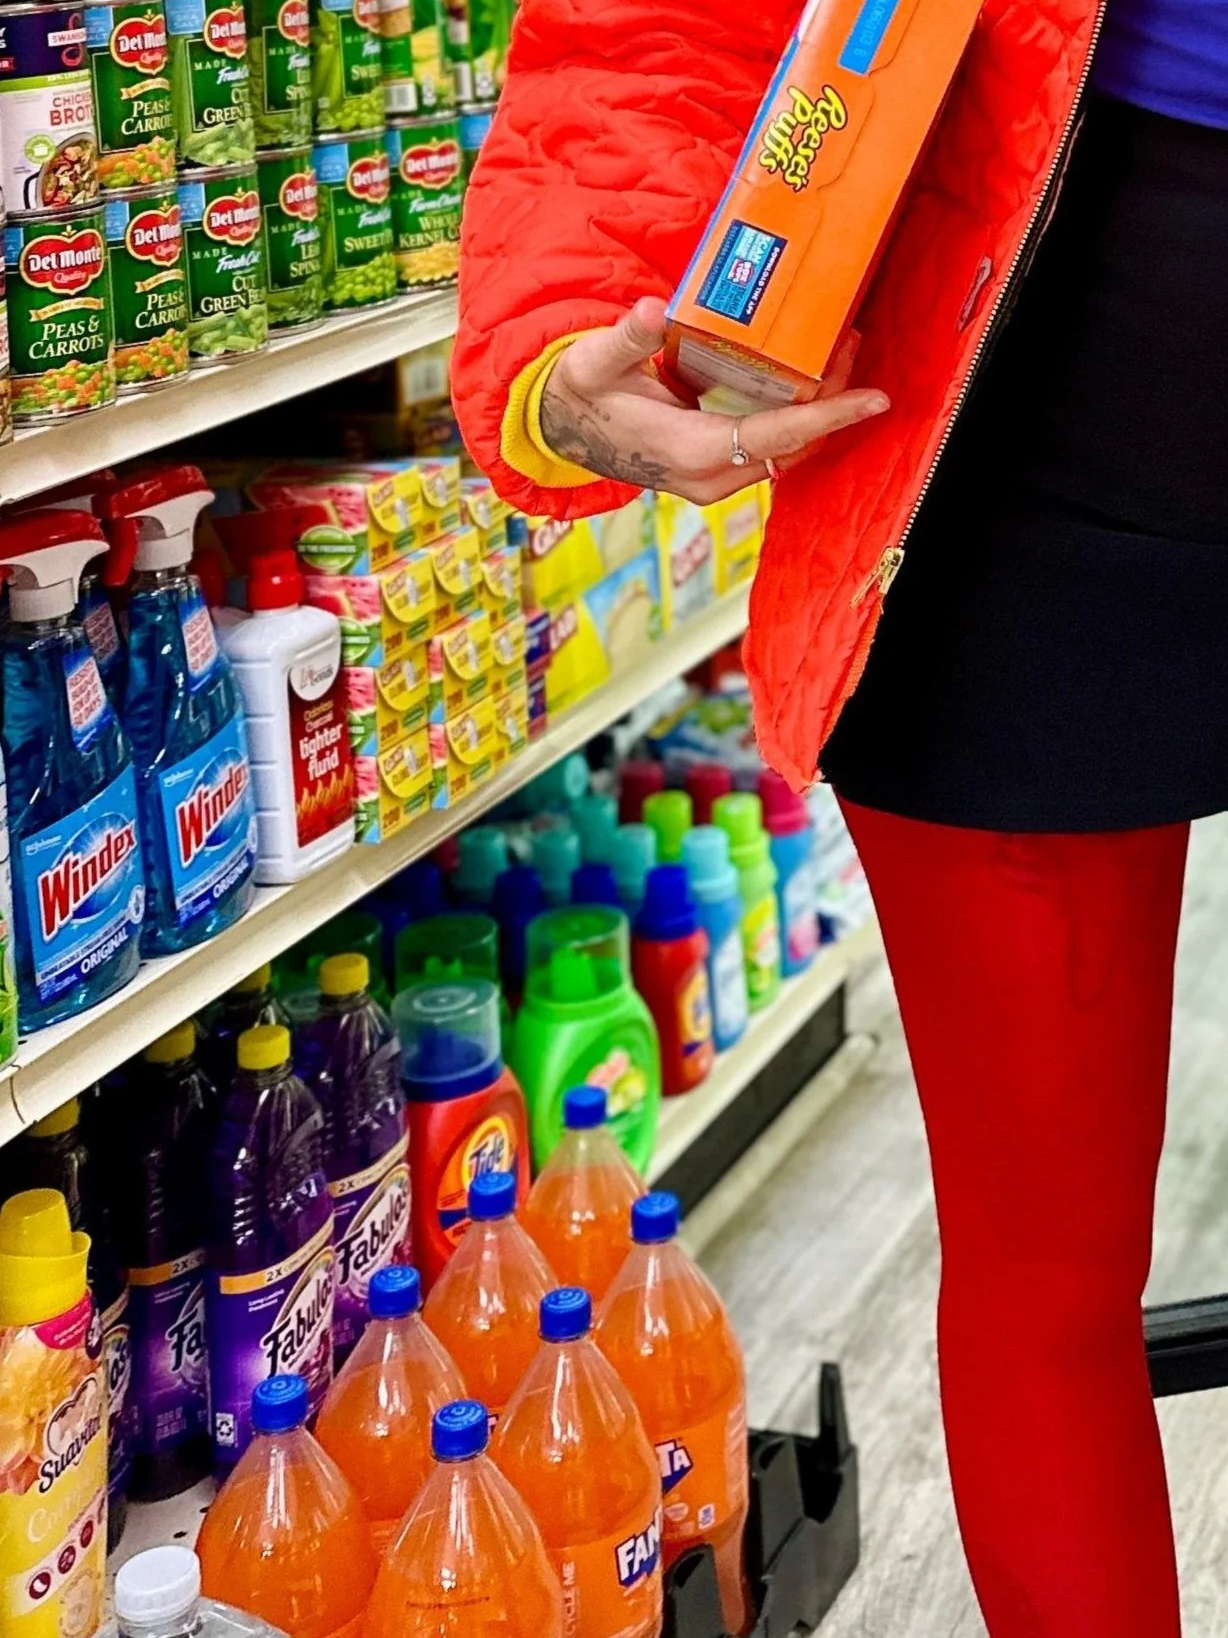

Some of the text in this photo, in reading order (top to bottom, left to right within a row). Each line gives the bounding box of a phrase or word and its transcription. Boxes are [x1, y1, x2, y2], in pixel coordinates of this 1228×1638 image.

[211, 23, 229, 39] Del
[118, 35, 143, 53] Del
[194, 59, 227, 71] MADE
[132, 99, 163, 118] PEAS
[783, 84, 848, 193] Reese's
[406, 157, 428, 173] Del
[353, 171, 372, 187] Del
[286, 189, 302, 204] Del
[211, 211, 232, 228] Del
[134, 228, 159, 246] Del
[28, 246, 101, 273] Del Monte
[192, 247, 228, 260] MADE
[146, 292, 176, 311] PEAS
[200, 294, 247, 314] GREEN
[43, 315, 100, 342] PEAS &
[28, 333, 104, 361] CARROTS
[308, 746, 340, 782] fluid
[38, 819, 138, 942] Windex
[80, 926, 129, 974] ORIGINAL
[265, 1268, 284, 1284] 2X
[562, 1561, 576, 1586] ME
